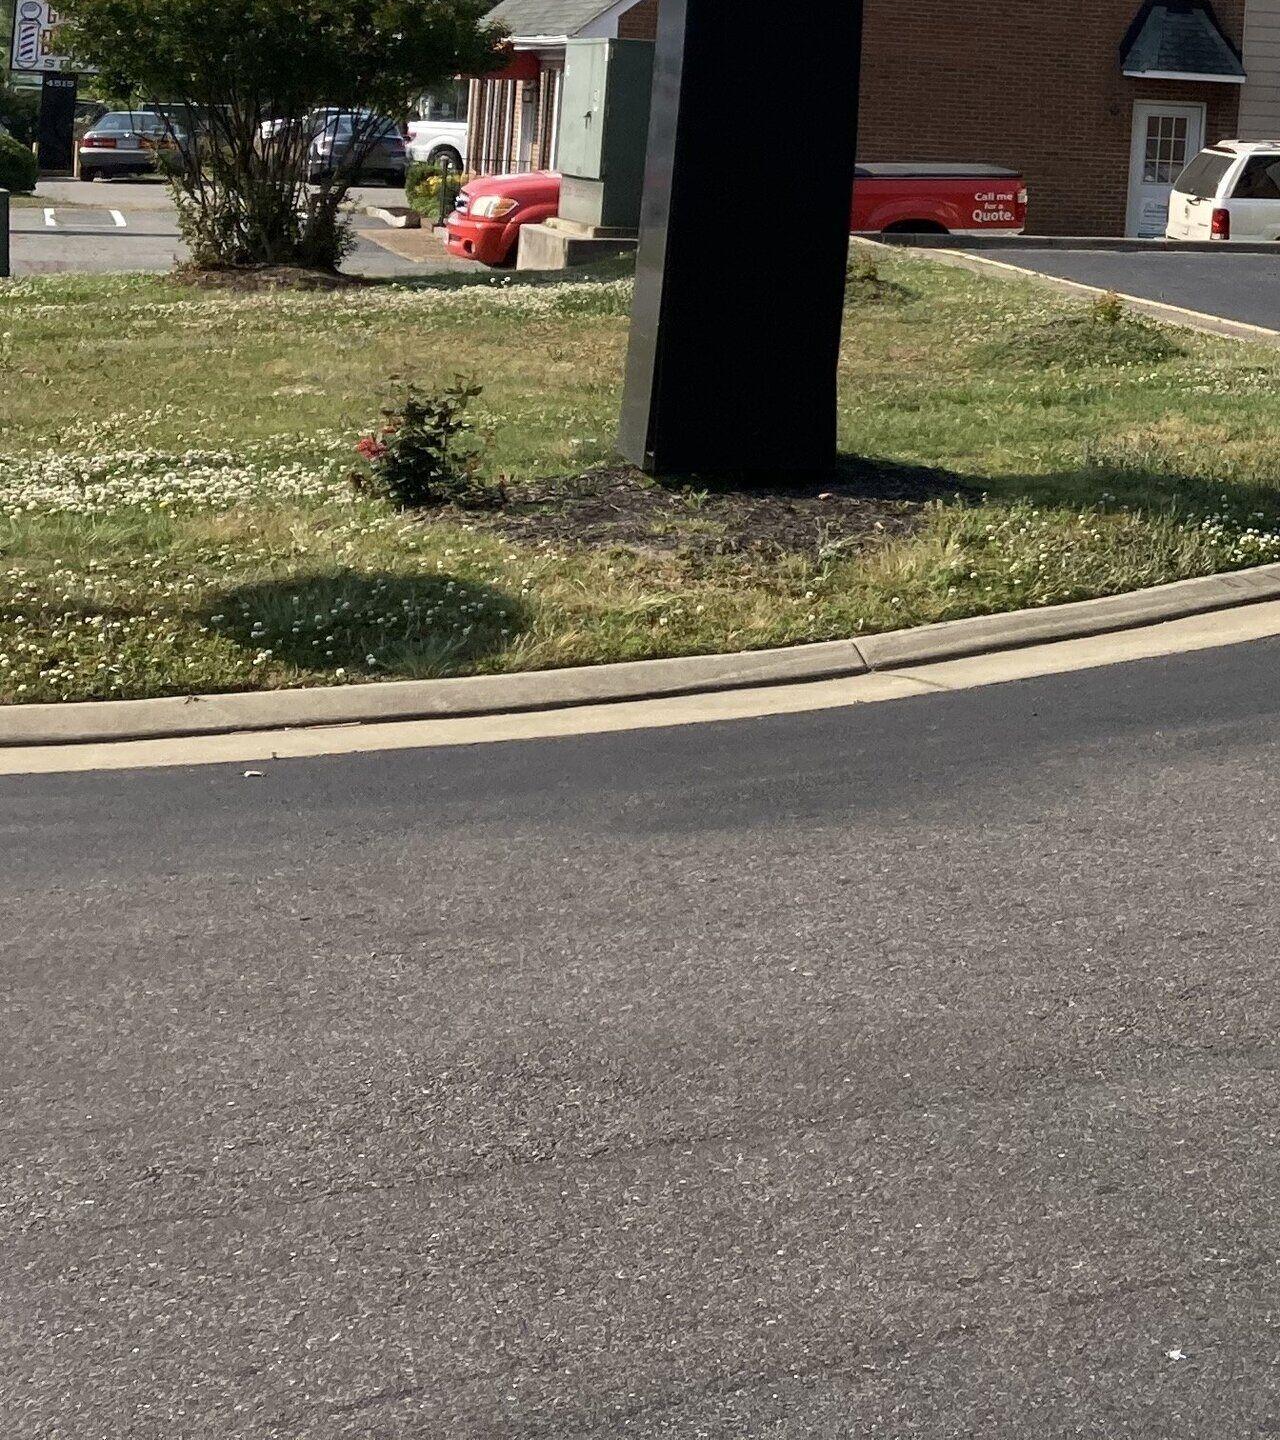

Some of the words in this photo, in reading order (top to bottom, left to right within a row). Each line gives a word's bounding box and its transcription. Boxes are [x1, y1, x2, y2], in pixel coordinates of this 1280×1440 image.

[974, 192, 995, 201] Call
[996, 193, 1013, 201] me
[984, 202, 997, 210] for
[972, 209, 1015, 223] Quote.
